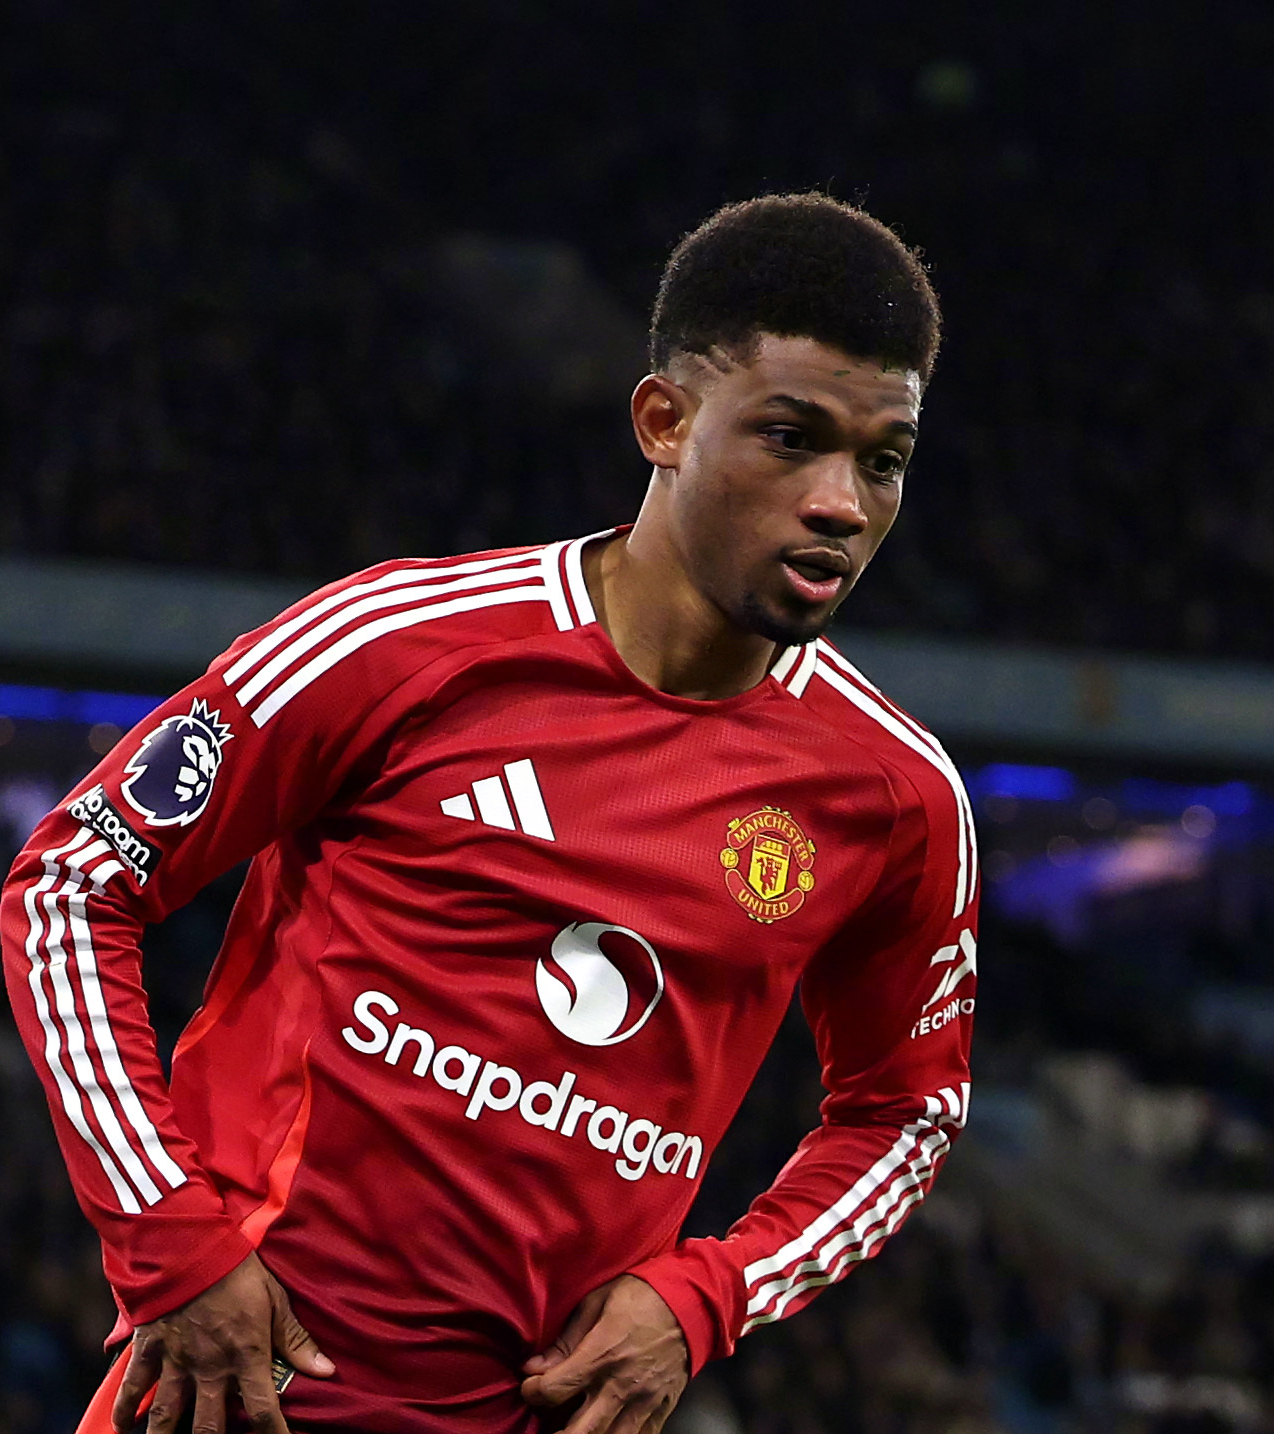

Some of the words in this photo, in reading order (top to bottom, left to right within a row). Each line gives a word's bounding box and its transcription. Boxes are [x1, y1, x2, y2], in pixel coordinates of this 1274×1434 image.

[96, 806, 151, 866] room
[733, 815, 808, 863] MANCHESTER
[738, 889, 789, 916] UNITED
[341, 990, 703, 1181] Snapdragon
